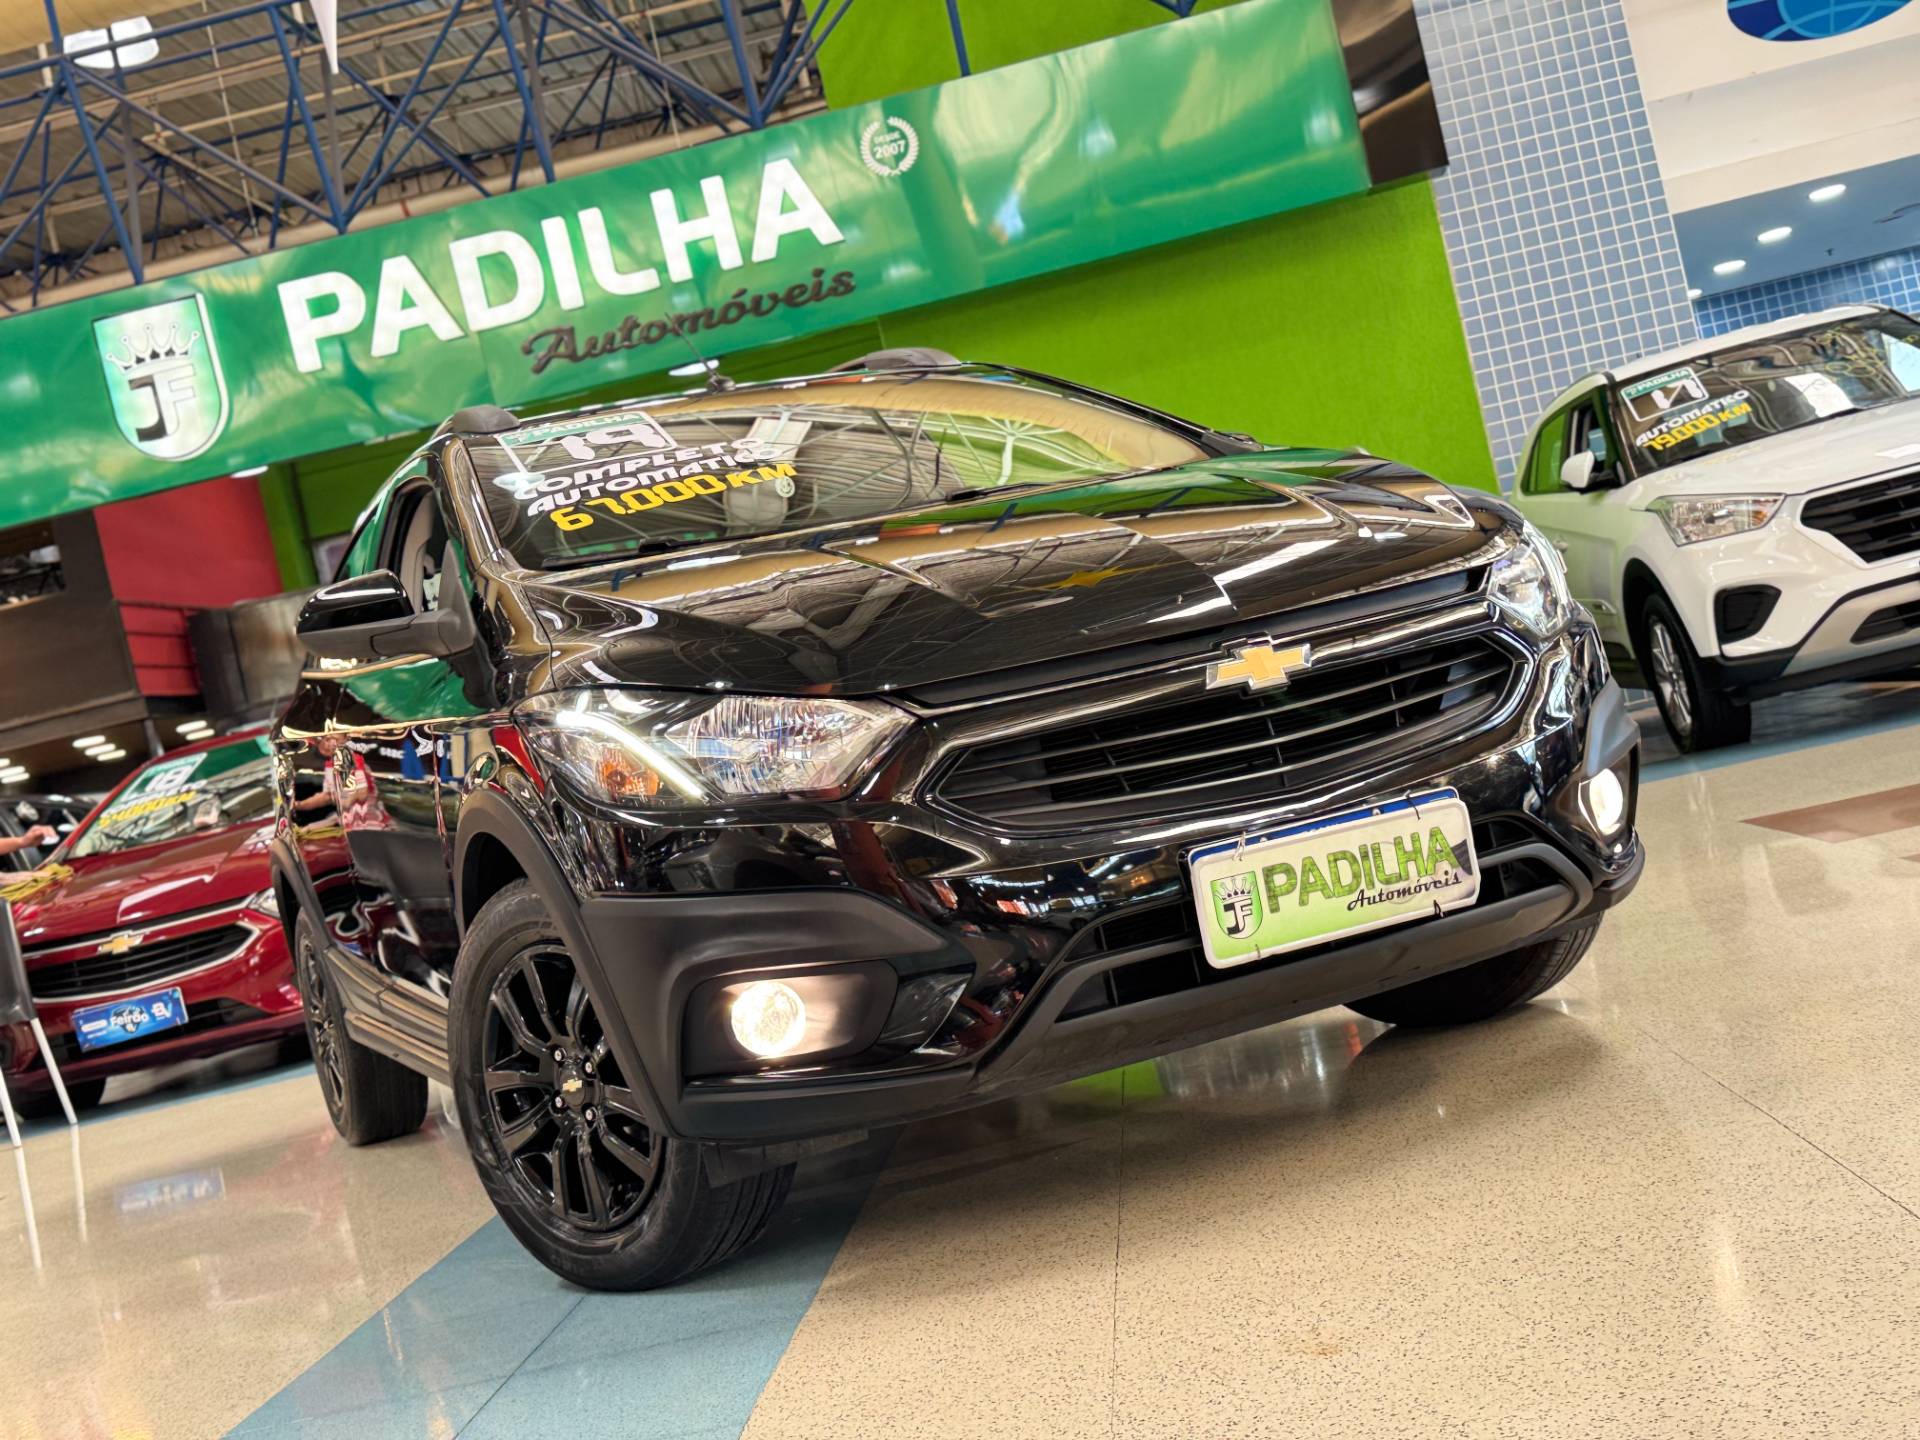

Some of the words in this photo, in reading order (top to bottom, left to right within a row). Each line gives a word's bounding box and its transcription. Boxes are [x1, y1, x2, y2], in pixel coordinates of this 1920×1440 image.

[873, 140, 906, 159] 2007
[277, 158, 845, 374] PADILHA
[521, 267, 856, 375] Automóveis
[1637, 370, 1690, 391] PADILHA
[532, 413, 642, 436] PADILHA
[1718, 402, 1752, 422] KM
[514, 438, 766, 500] COMPLETO
[726, 463, 798, 489] KM
[145, 764, 194, 793] 18
[1262, 826, 1458, 914] PADILHA
[1347, 870, 1463, 912] Automóveis
